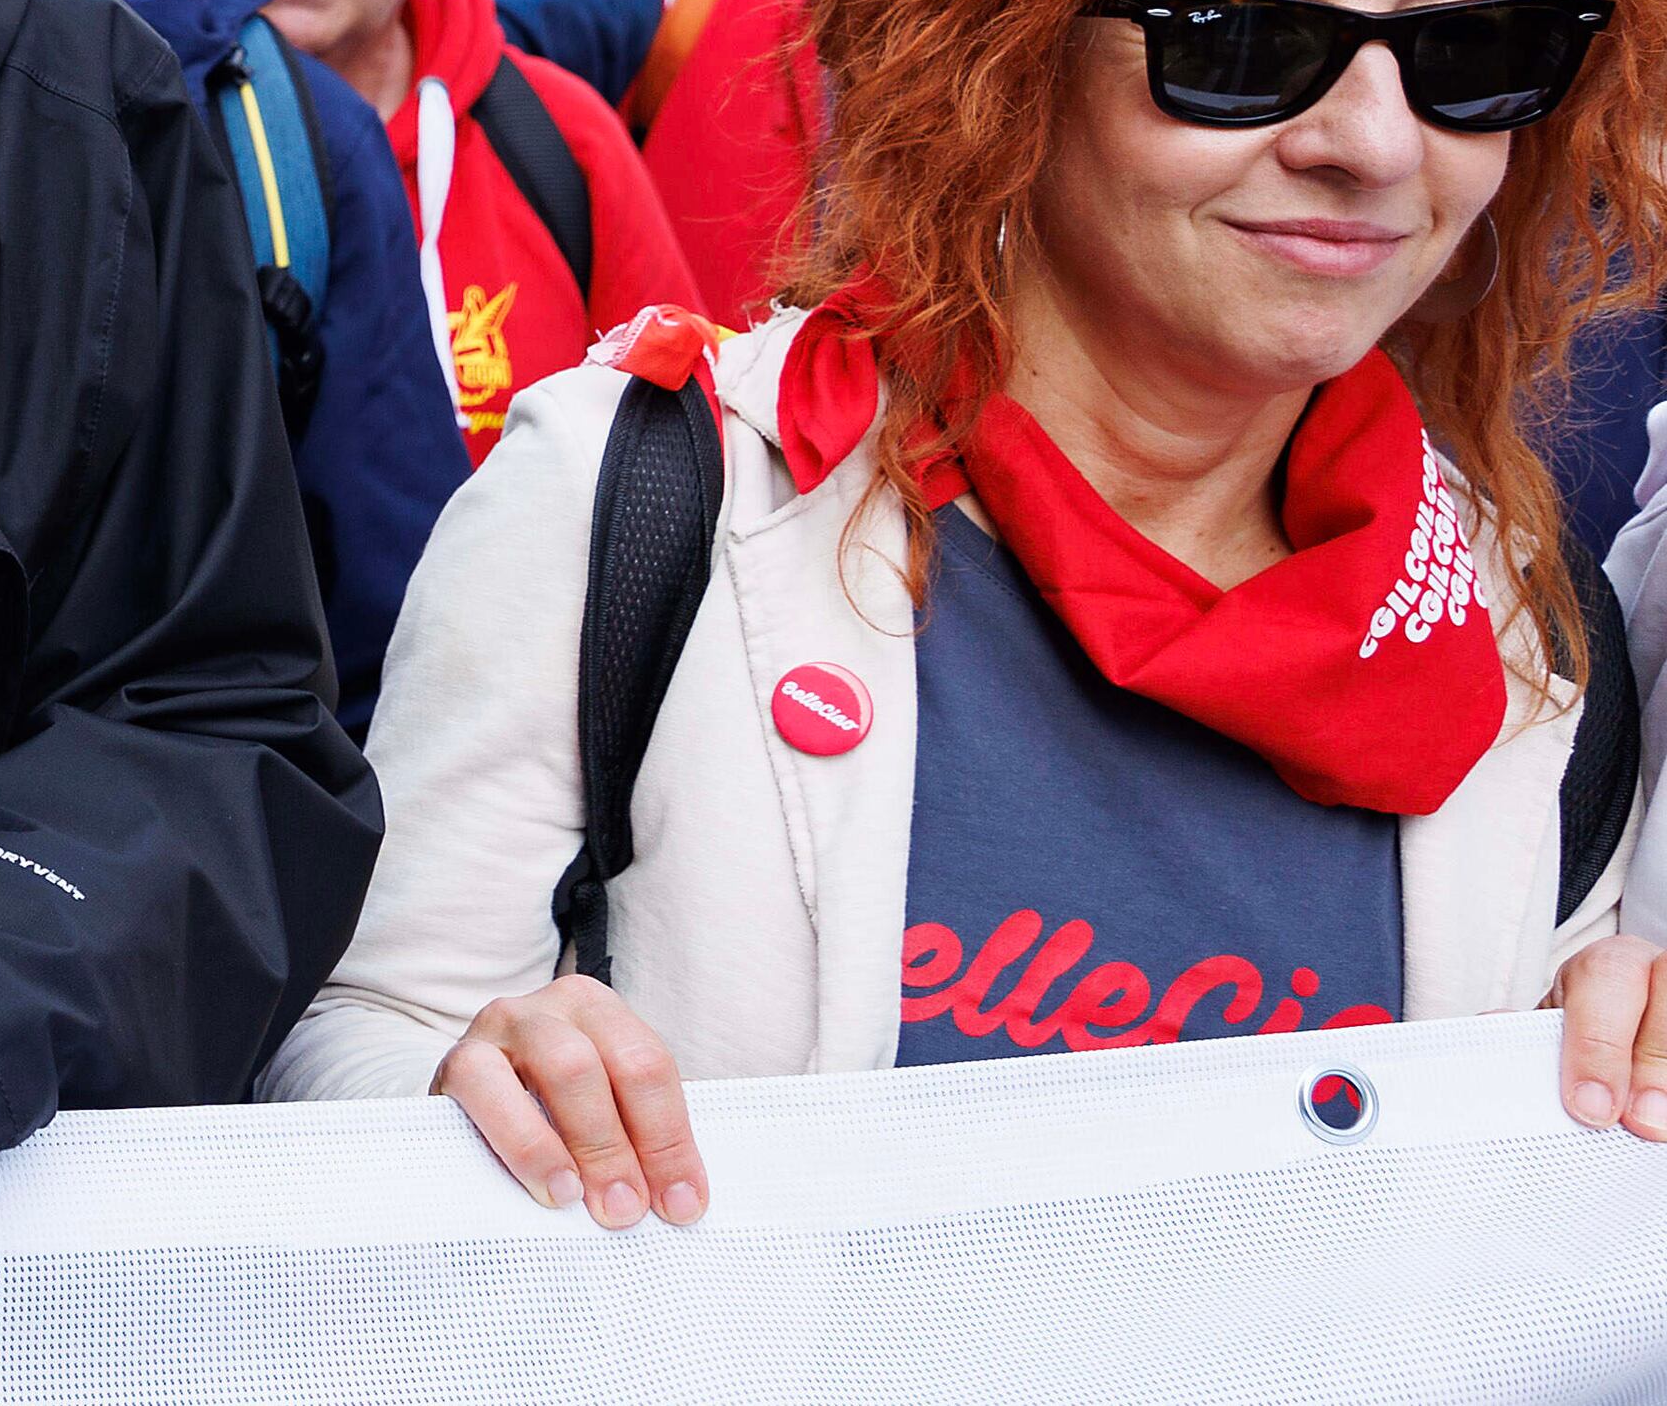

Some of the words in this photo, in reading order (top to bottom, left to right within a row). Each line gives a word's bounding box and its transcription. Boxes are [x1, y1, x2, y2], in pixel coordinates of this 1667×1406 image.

[1359, 579, 1422, 658] CGIL
[1405, 501, 1435, 582] CGIL
[1405, 562, 1450, 643] CGIL
